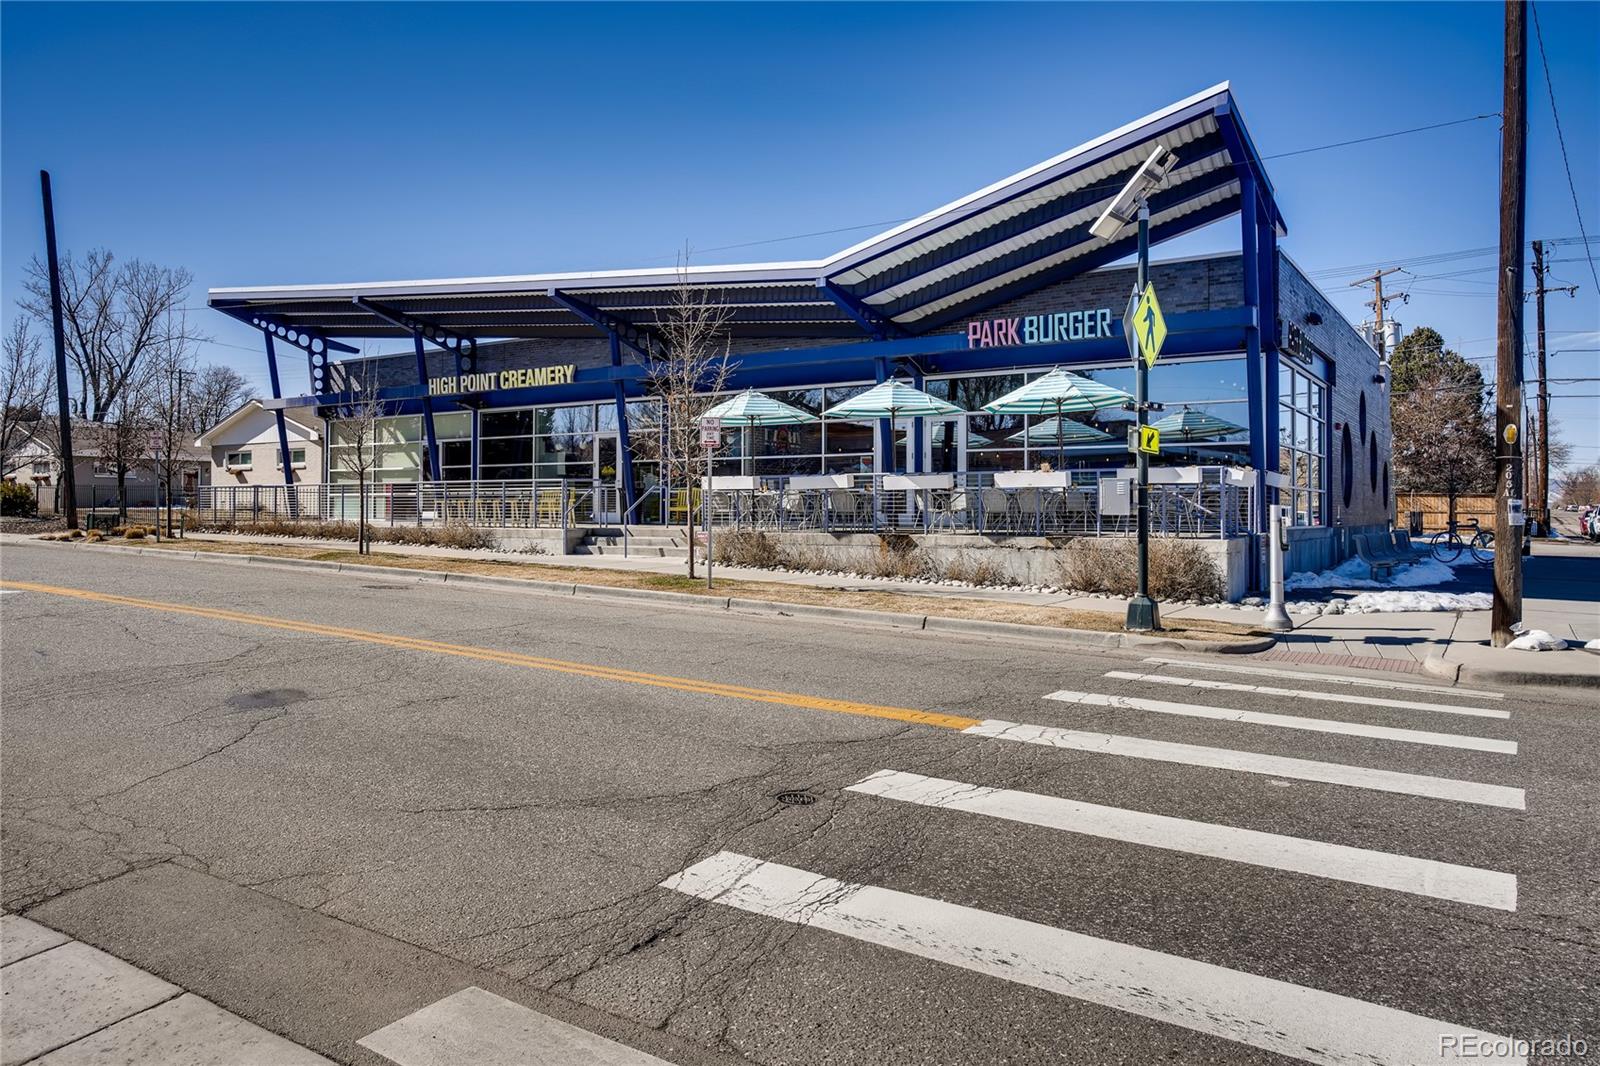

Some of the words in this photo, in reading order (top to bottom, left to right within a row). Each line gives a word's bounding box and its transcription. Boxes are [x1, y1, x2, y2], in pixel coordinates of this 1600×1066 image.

[968, 317, 1021, 349] PARK
[1024, 308, 1112, 344] BURGER
[428, 376, 457, 395] HIGH
[460, 372, 497, 393] POINT
[500, 364, 576, 389] CREAMERY
